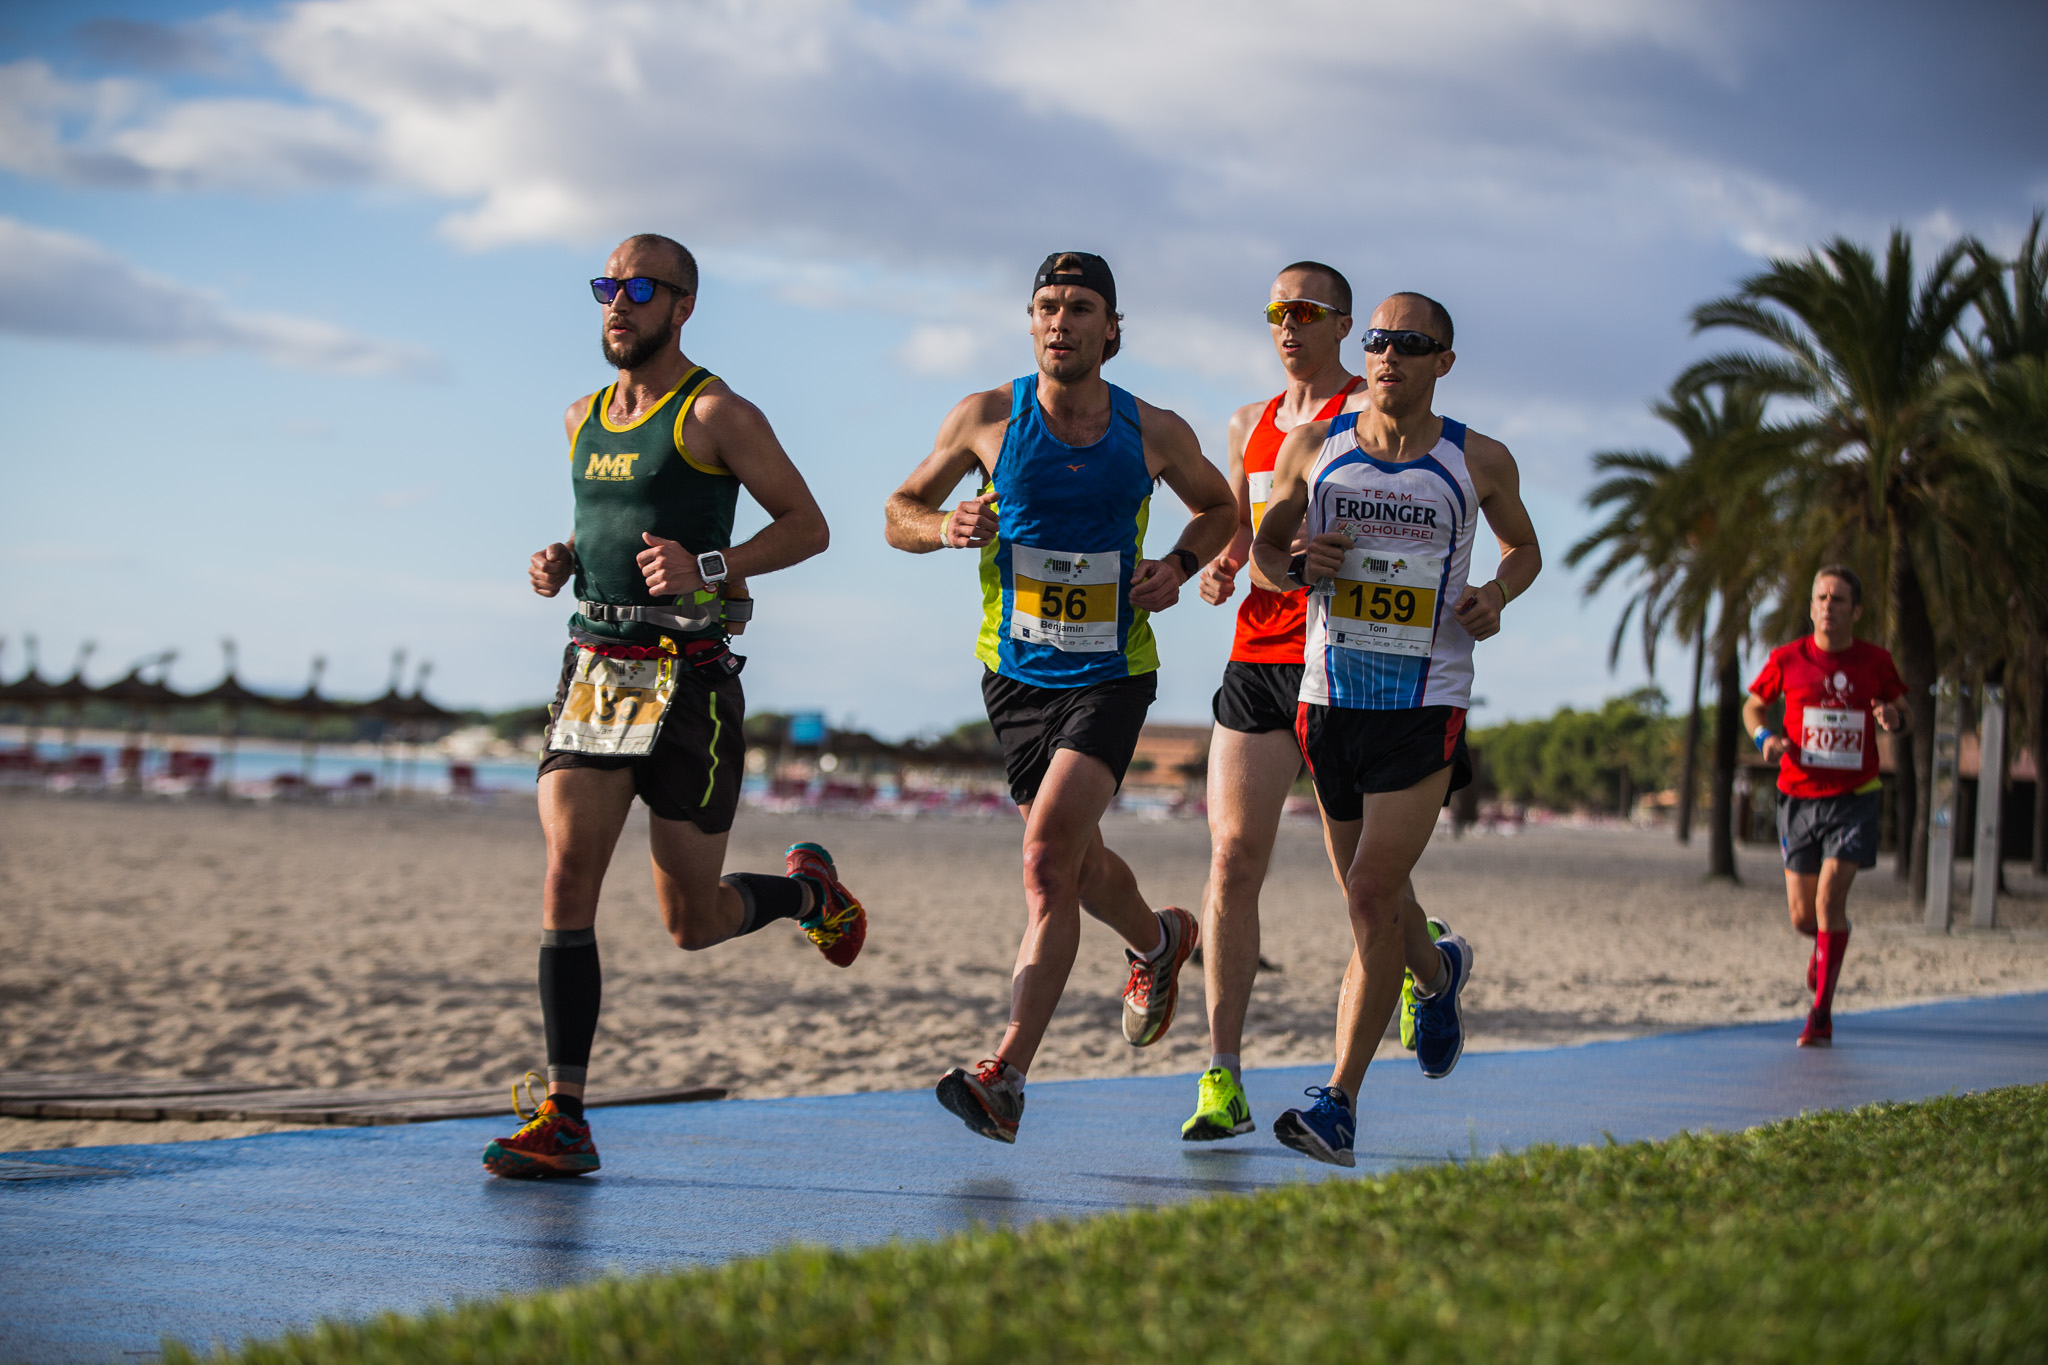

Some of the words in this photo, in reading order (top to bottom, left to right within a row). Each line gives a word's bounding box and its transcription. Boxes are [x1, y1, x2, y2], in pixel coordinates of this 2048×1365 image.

[1362, 489, 1412, 502] TEAM
[1335, 497, 1437, 529] ERDINGER
[1337, 522, 1434, 540] OHOLFREI
[1041, 585, 1087, 620] 56
[1349, 584, 1416, 623] 159
[1040, 621, 1084, 633] Benjamin
[1368, 623, 1388, 633] Tom
[1806, 727, 1859, 752] 2022
